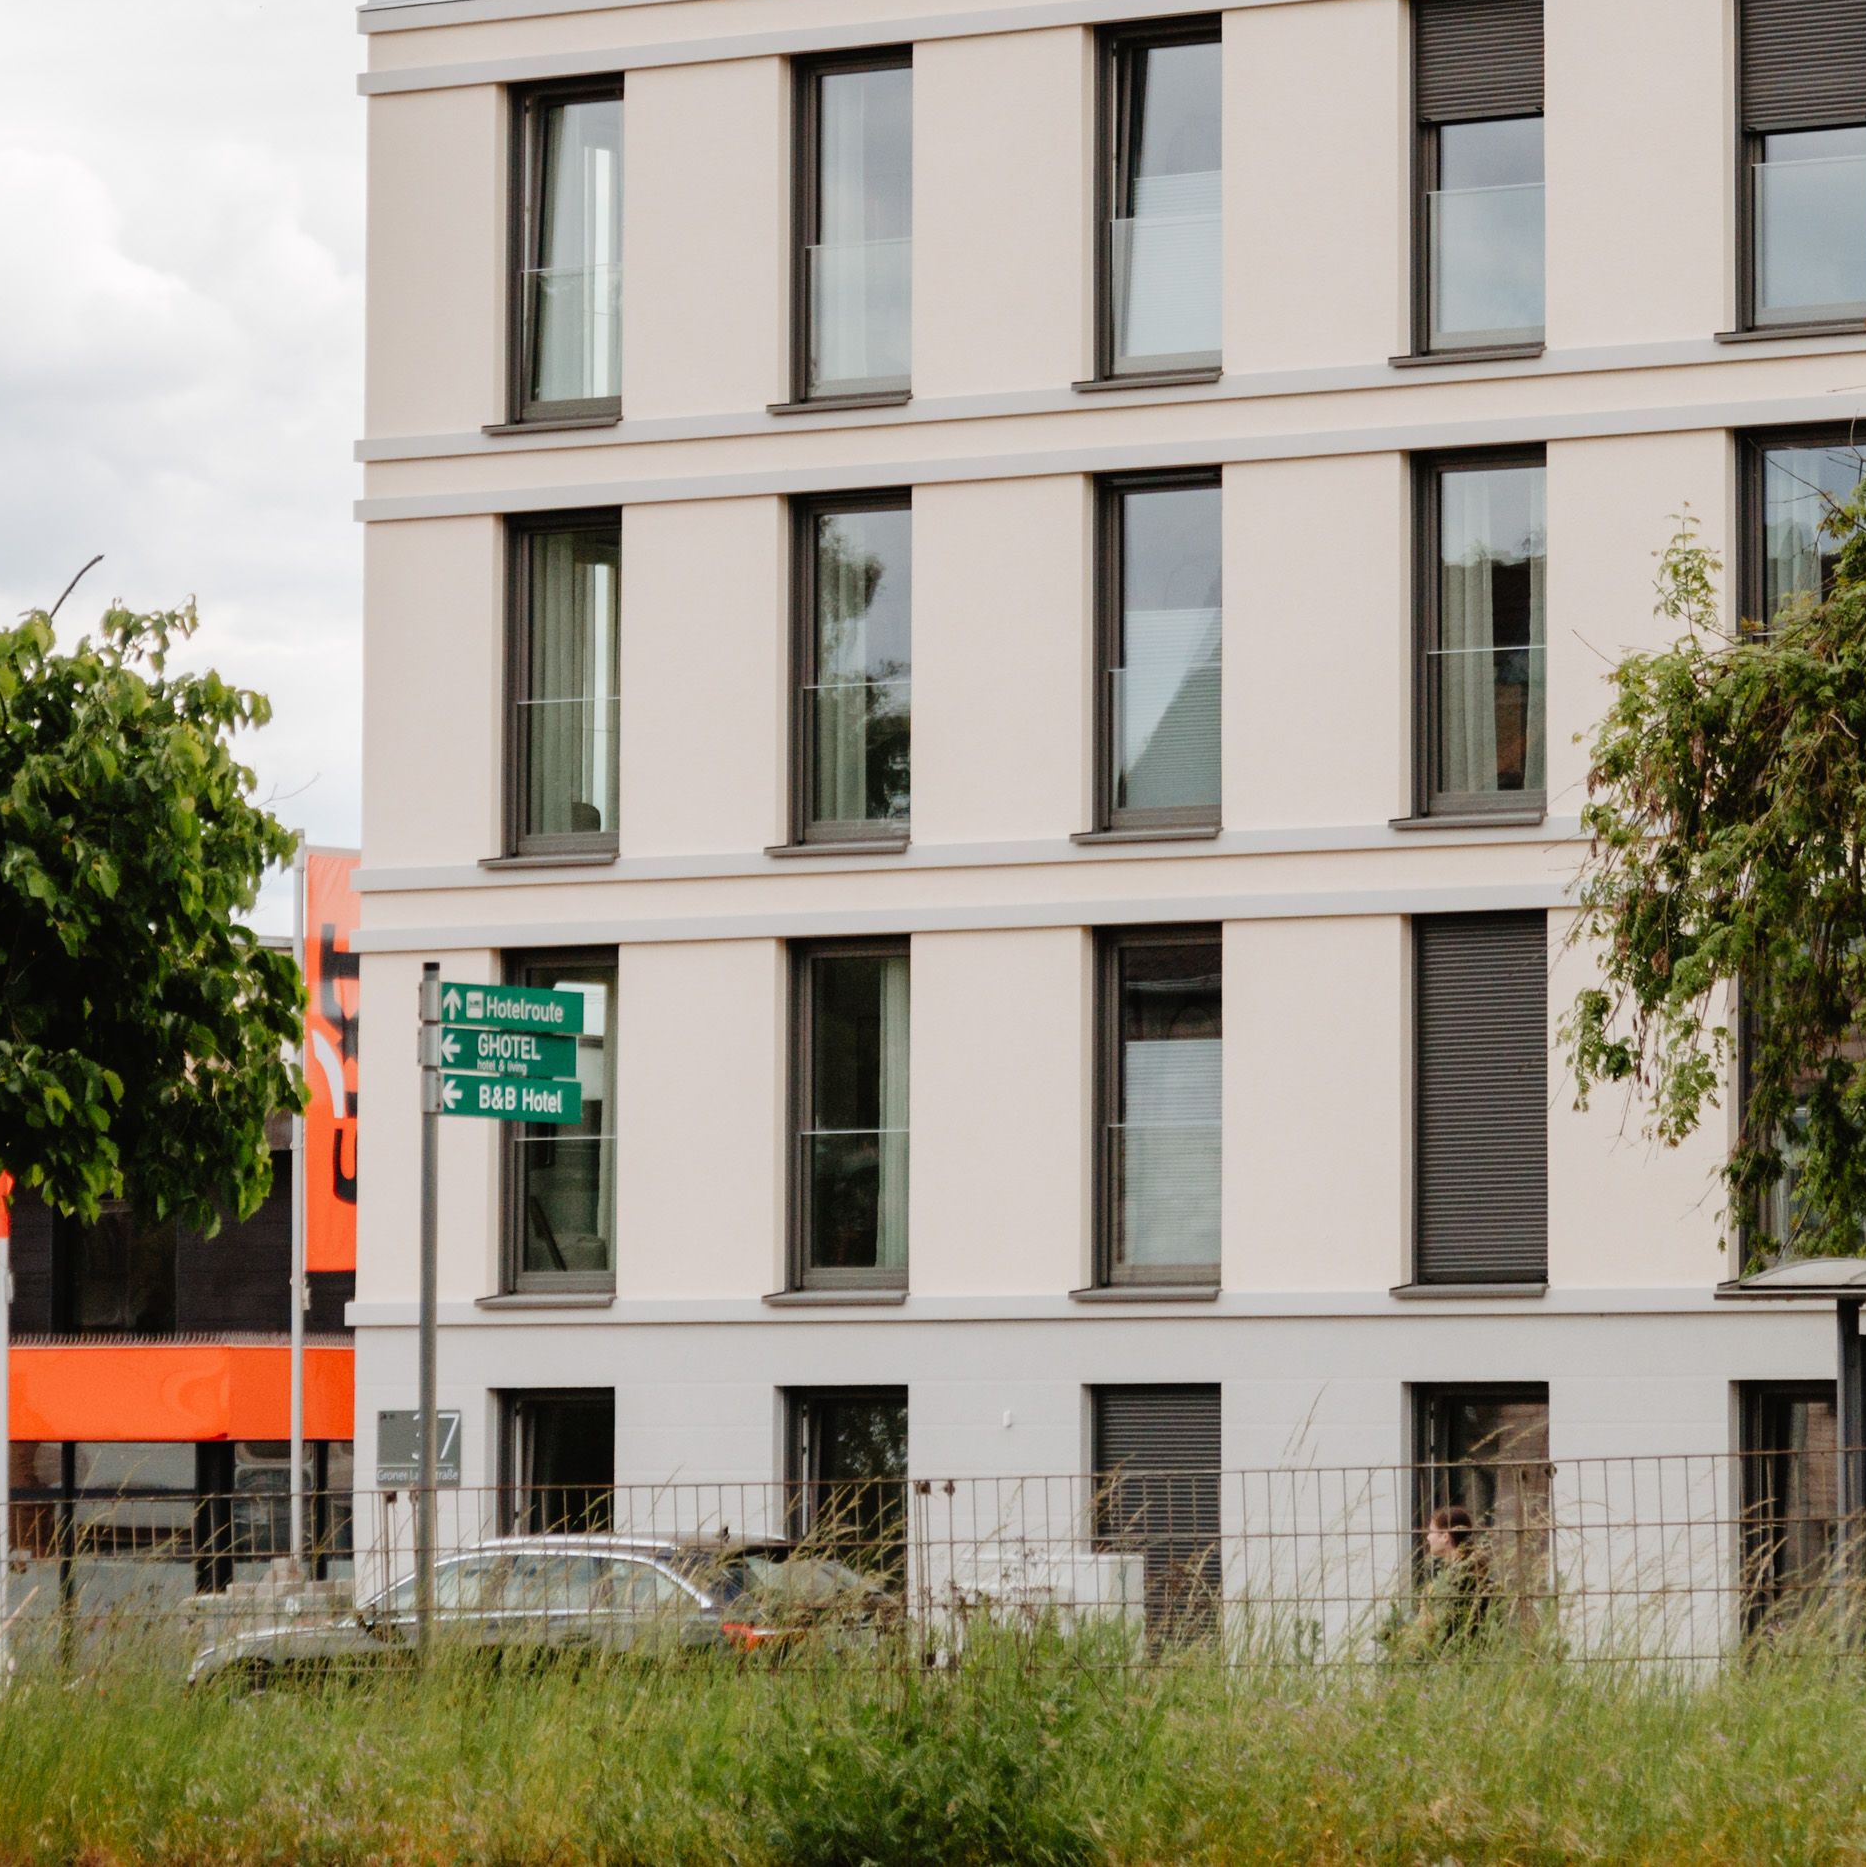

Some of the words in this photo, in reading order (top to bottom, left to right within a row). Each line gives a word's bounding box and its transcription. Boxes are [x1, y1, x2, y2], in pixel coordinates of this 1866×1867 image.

[486, 995, 564, 1023] Hotelroute
[477, 1033, 542, 1061] GHOTEL
[477, 1059, 496, 1071] hotel
[498, 1059, 506, 1072] &
[507, 1060, 528, 1075] living
[479, 1084, 517, 1111] B&B
[522, 1088, 563, 1114] Hotel
